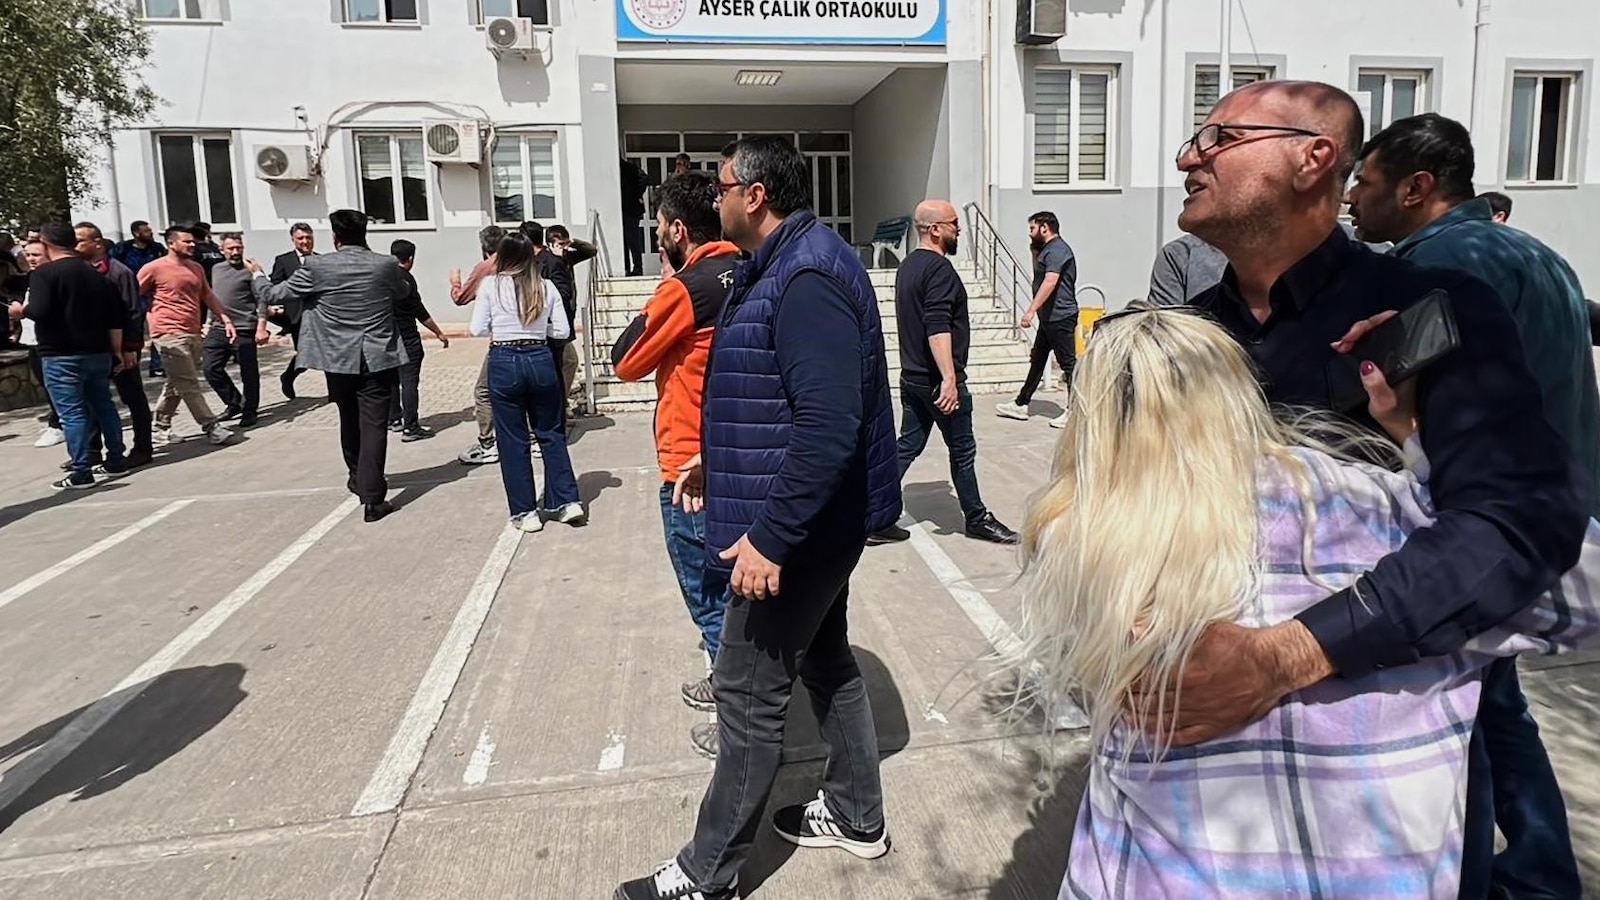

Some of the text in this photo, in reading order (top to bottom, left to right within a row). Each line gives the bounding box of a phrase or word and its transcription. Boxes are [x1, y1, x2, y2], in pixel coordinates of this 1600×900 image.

[699, 0, 917, 19] AYSER ÇALIK ORTAOKULU
